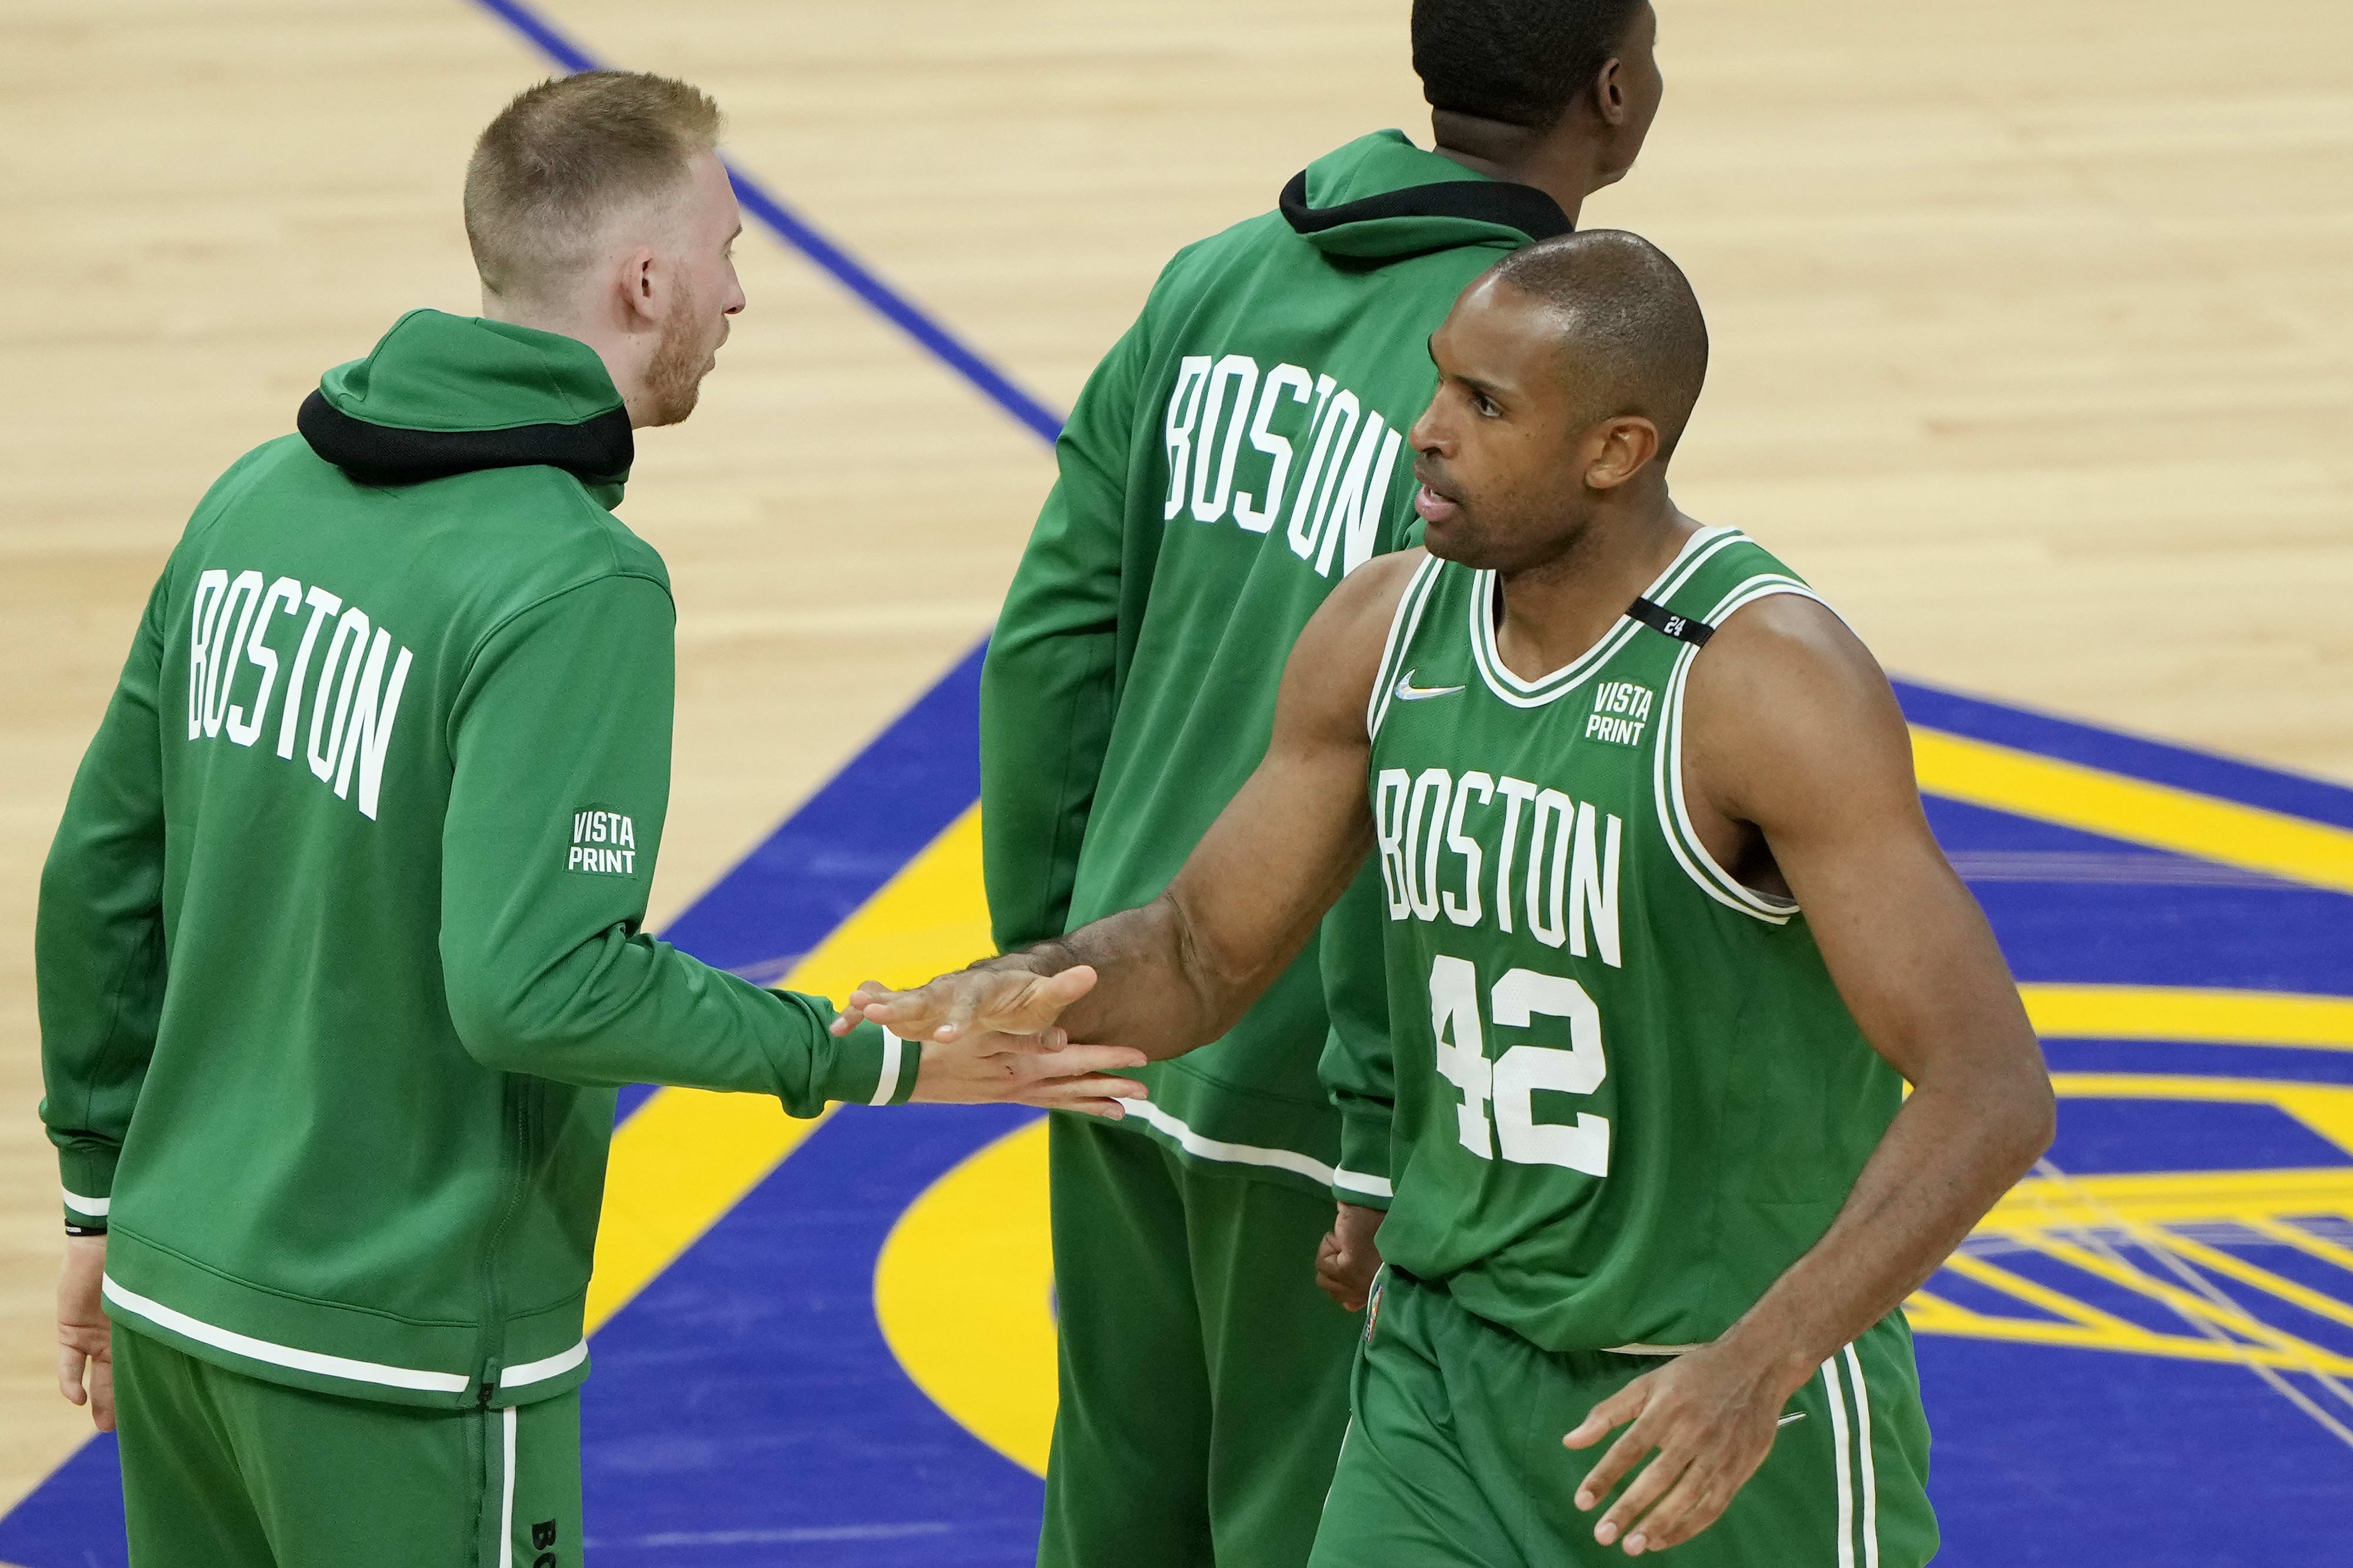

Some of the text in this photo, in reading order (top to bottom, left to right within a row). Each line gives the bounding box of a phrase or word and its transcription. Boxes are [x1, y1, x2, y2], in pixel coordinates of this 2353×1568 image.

[1164, 354, 1402, 578] BOSON
[1664, 616, 1686, 636] 24
[188, 569, 413, 821] BOSTON
[1594, 682, 1653, 722] VISTA
[1585, 714, 1645, 746] PRINT
[574, 811, 635, 850] VISTA
[568, 846, 636, 873] PRINT
[1377, 768, 1622, 968] BOSTON
[1429, 954, 1610, 1177] 42
